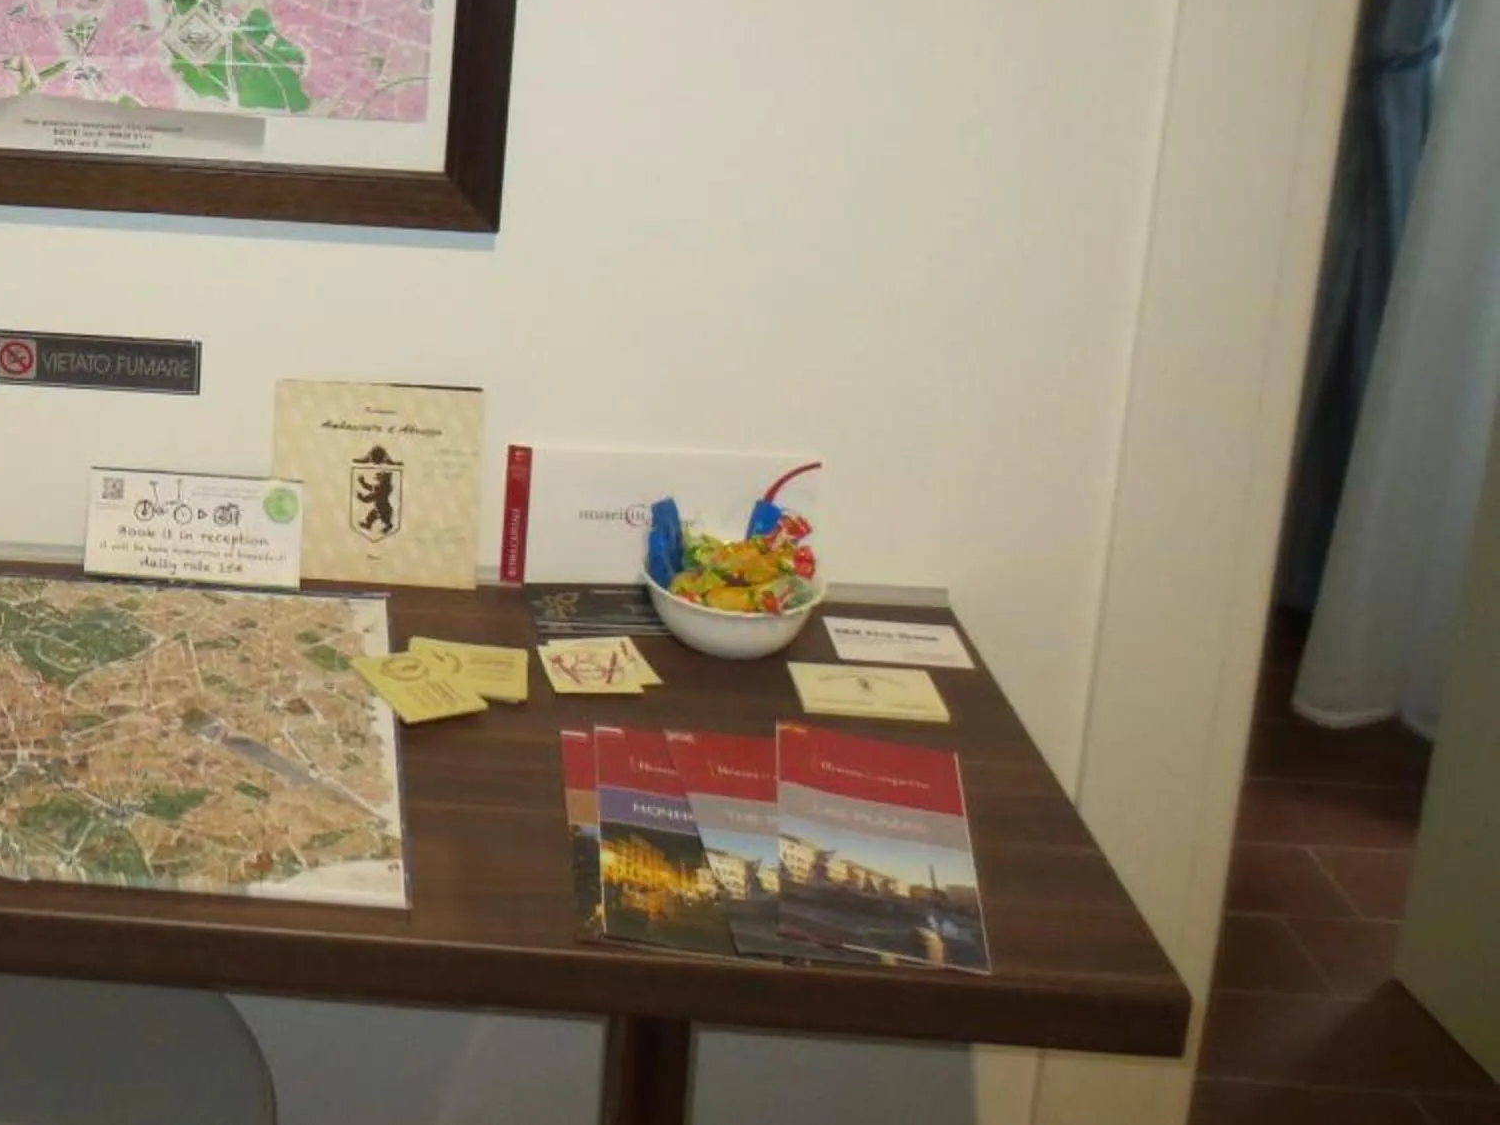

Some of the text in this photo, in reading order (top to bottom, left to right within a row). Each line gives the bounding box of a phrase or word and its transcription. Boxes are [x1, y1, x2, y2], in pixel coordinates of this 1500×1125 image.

[41, 350, 192, 379] VIETATO FUMARE
[180, 528, 193, 540] in
[201, 530, 269, 550] reception
